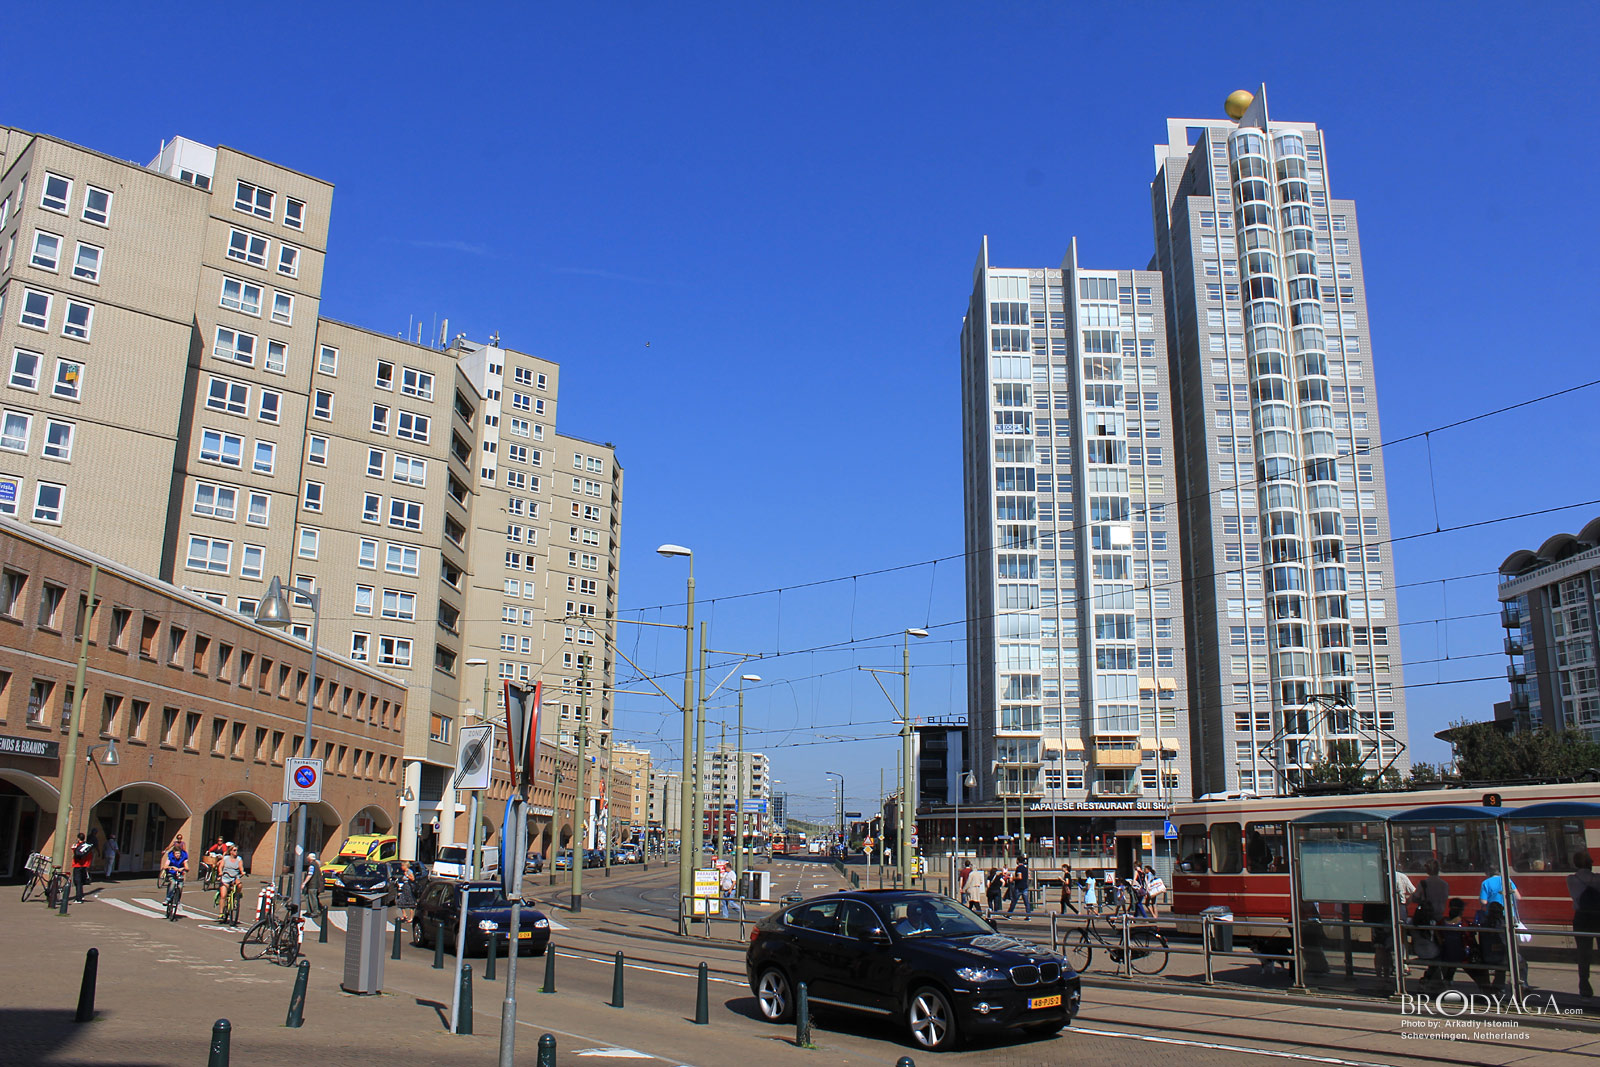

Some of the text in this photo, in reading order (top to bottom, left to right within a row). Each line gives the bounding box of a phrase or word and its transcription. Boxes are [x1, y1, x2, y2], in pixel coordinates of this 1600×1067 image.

[15, 740, 21, 752] &
[21, 740, 46, 754] BRANDS
[1490, 795, 1496, 805] 9
[1030, 802, 1074, 811] JAPANESE
[1076, 802, 1134, 810] RESTAURANT
[1136, 802, 1151, 810] SUI
